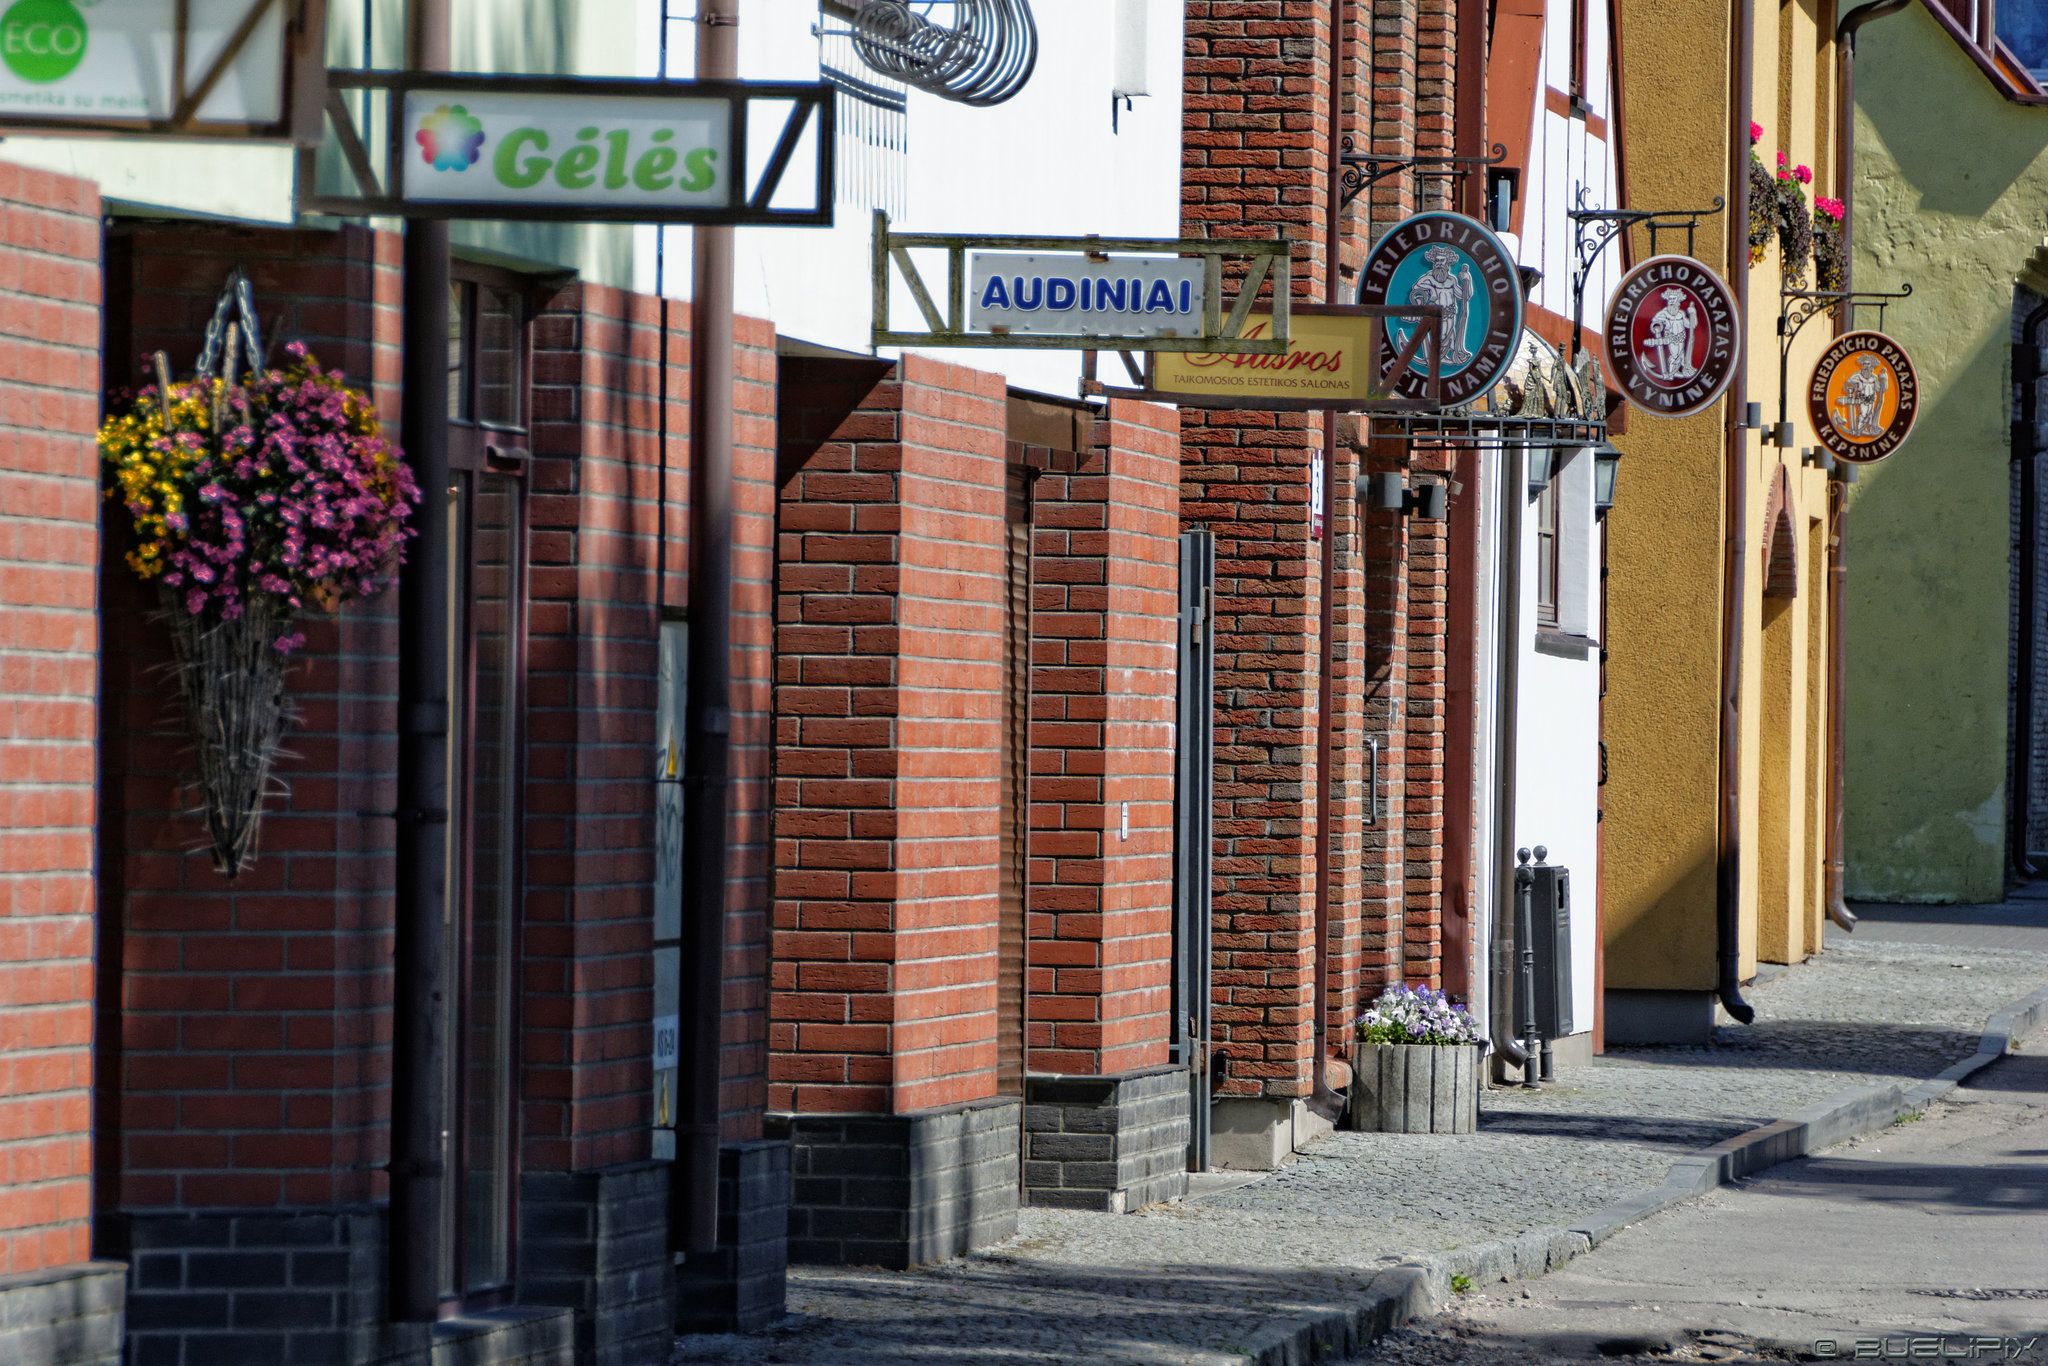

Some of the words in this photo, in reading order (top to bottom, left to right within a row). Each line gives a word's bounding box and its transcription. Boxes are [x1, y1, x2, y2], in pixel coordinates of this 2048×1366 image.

[6, 23, 82, 55] ECO
[493, 126, 717, 192] Gėlės
[1367, 221, 1509, 294] FRIEDRICHO
[981, 275, 1192, 314] AUDINIAI
[1613, 265, 1690, 358] FRIEDRICHO
[1173, 374, 1244, 386] TAIKOMOSIOS
[1247, 377, 1297, 388] ESTETIKOS
[1300, 379, 1350, 390] SALONAS
[1447, 330, 1509, 397] NAMAI
[1812, 337, 1878, 401] FRIEDRICHO
